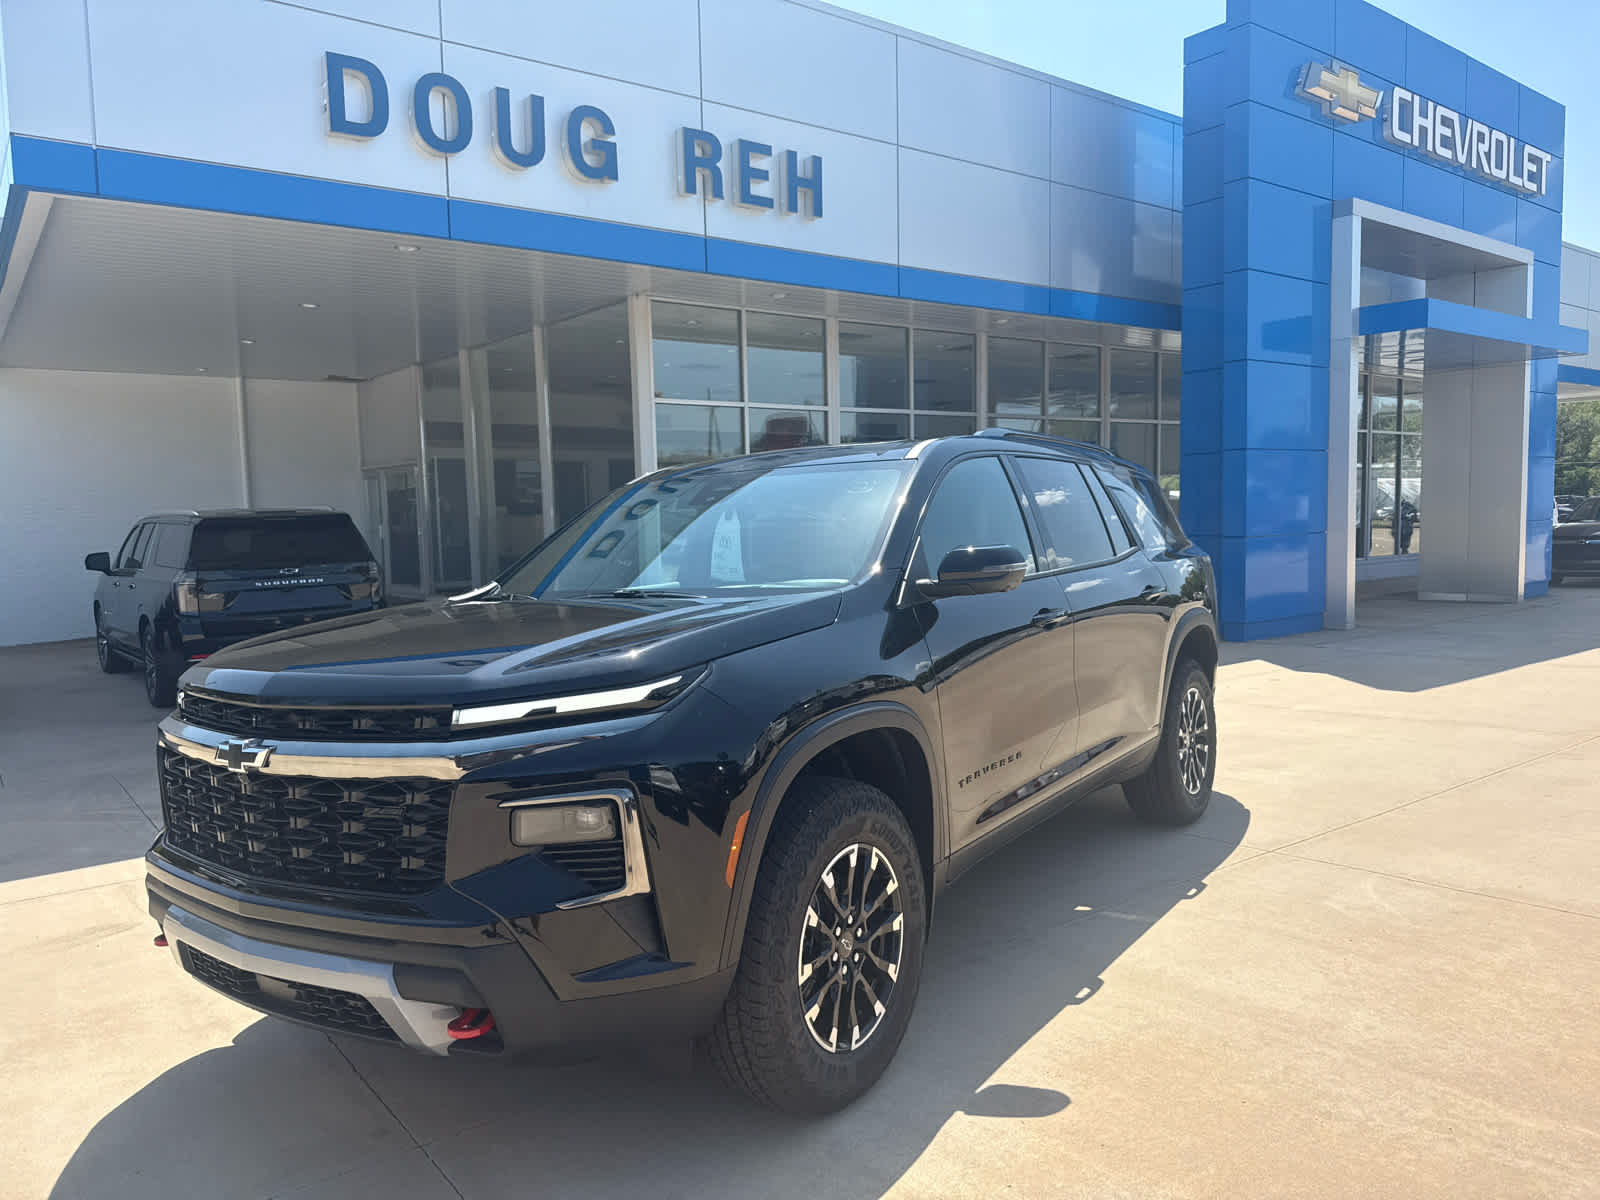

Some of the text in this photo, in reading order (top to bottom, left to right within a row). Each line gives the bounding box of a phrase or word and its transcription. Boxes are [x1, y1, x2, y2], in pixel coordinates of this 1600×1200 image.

[324, 51, 823, 219] DOUG REH
[1391, 86, 1552, 196] CHEVROLET
[958, 751, 1022, 789] TRAVERSE
